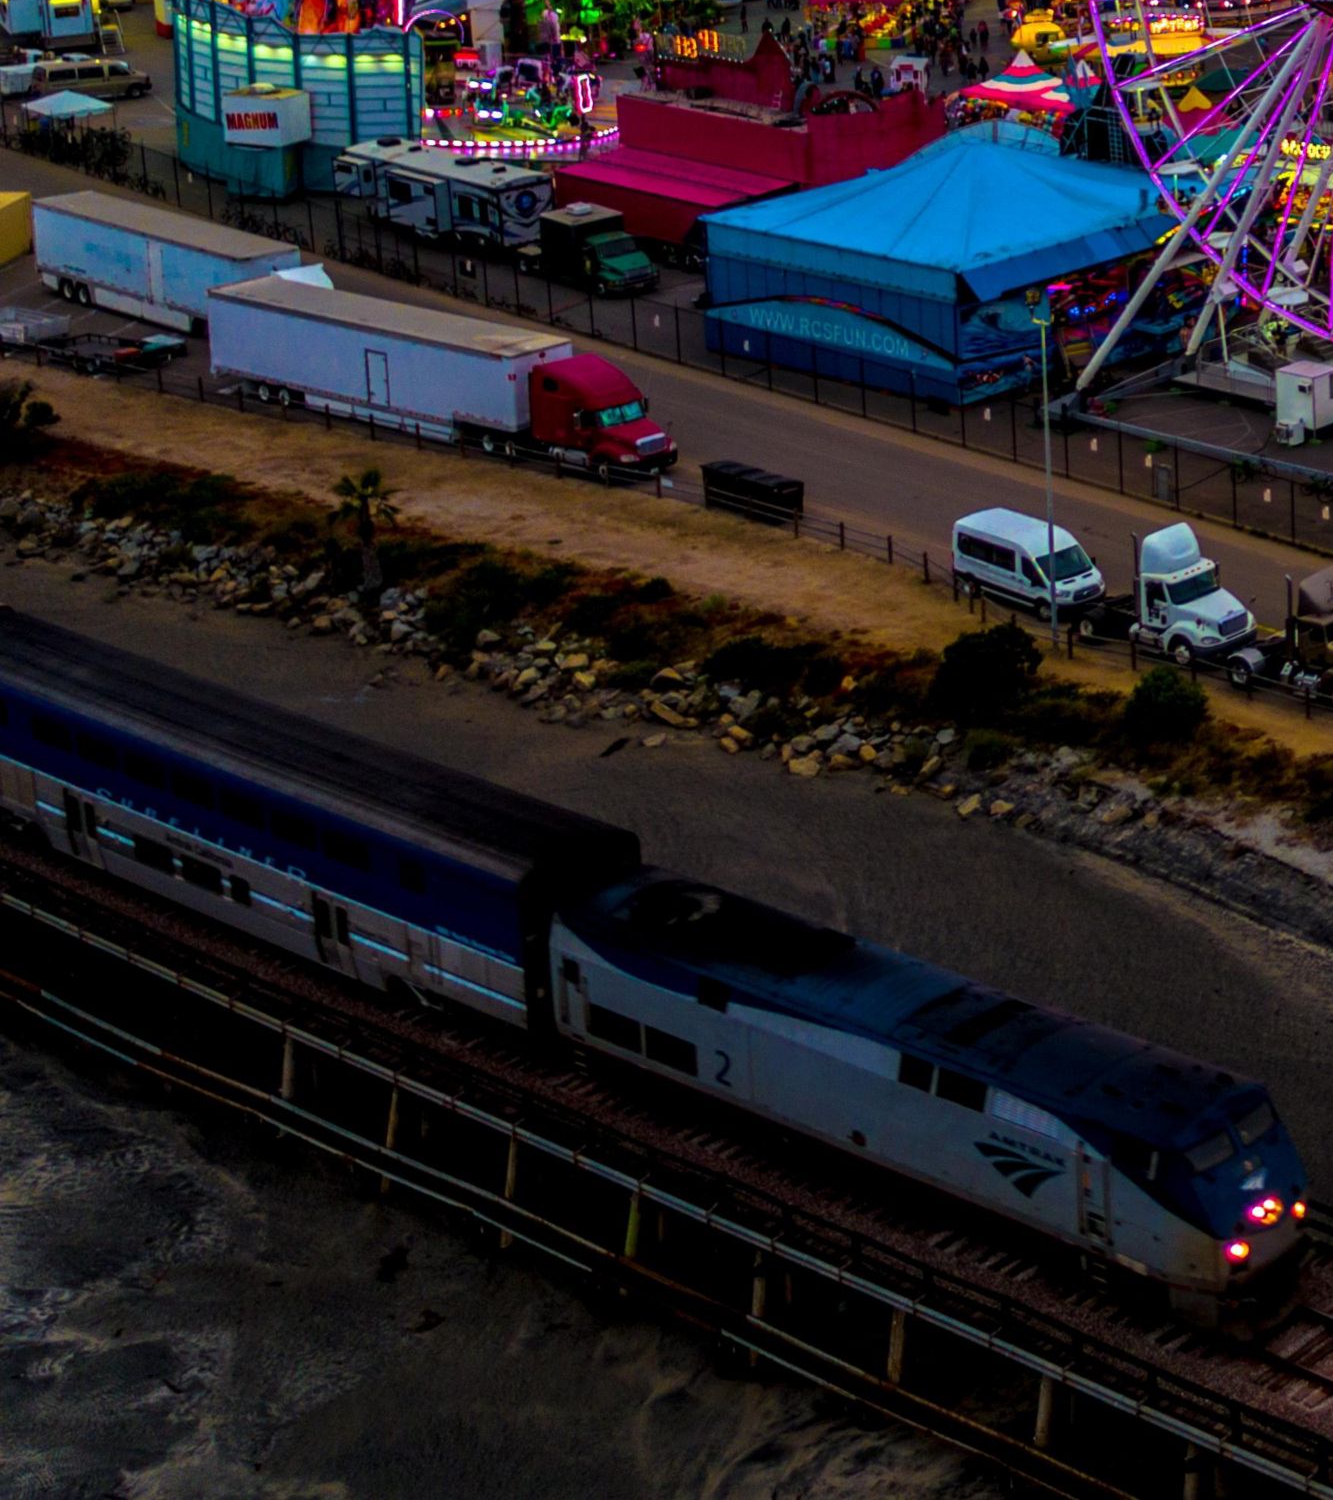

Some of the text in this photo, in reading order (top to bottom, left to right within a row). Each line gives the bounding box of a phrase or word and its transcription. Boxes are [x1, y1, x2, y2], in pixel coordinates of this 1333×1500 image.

[225, 111, 279, 131] MAGNUM
[750, 308, 909, 357] WWW.RCSFUN.COM
[714, 1050, 732, 1087] 2
[987, 1130, 1065, 1168] AMTRAK
